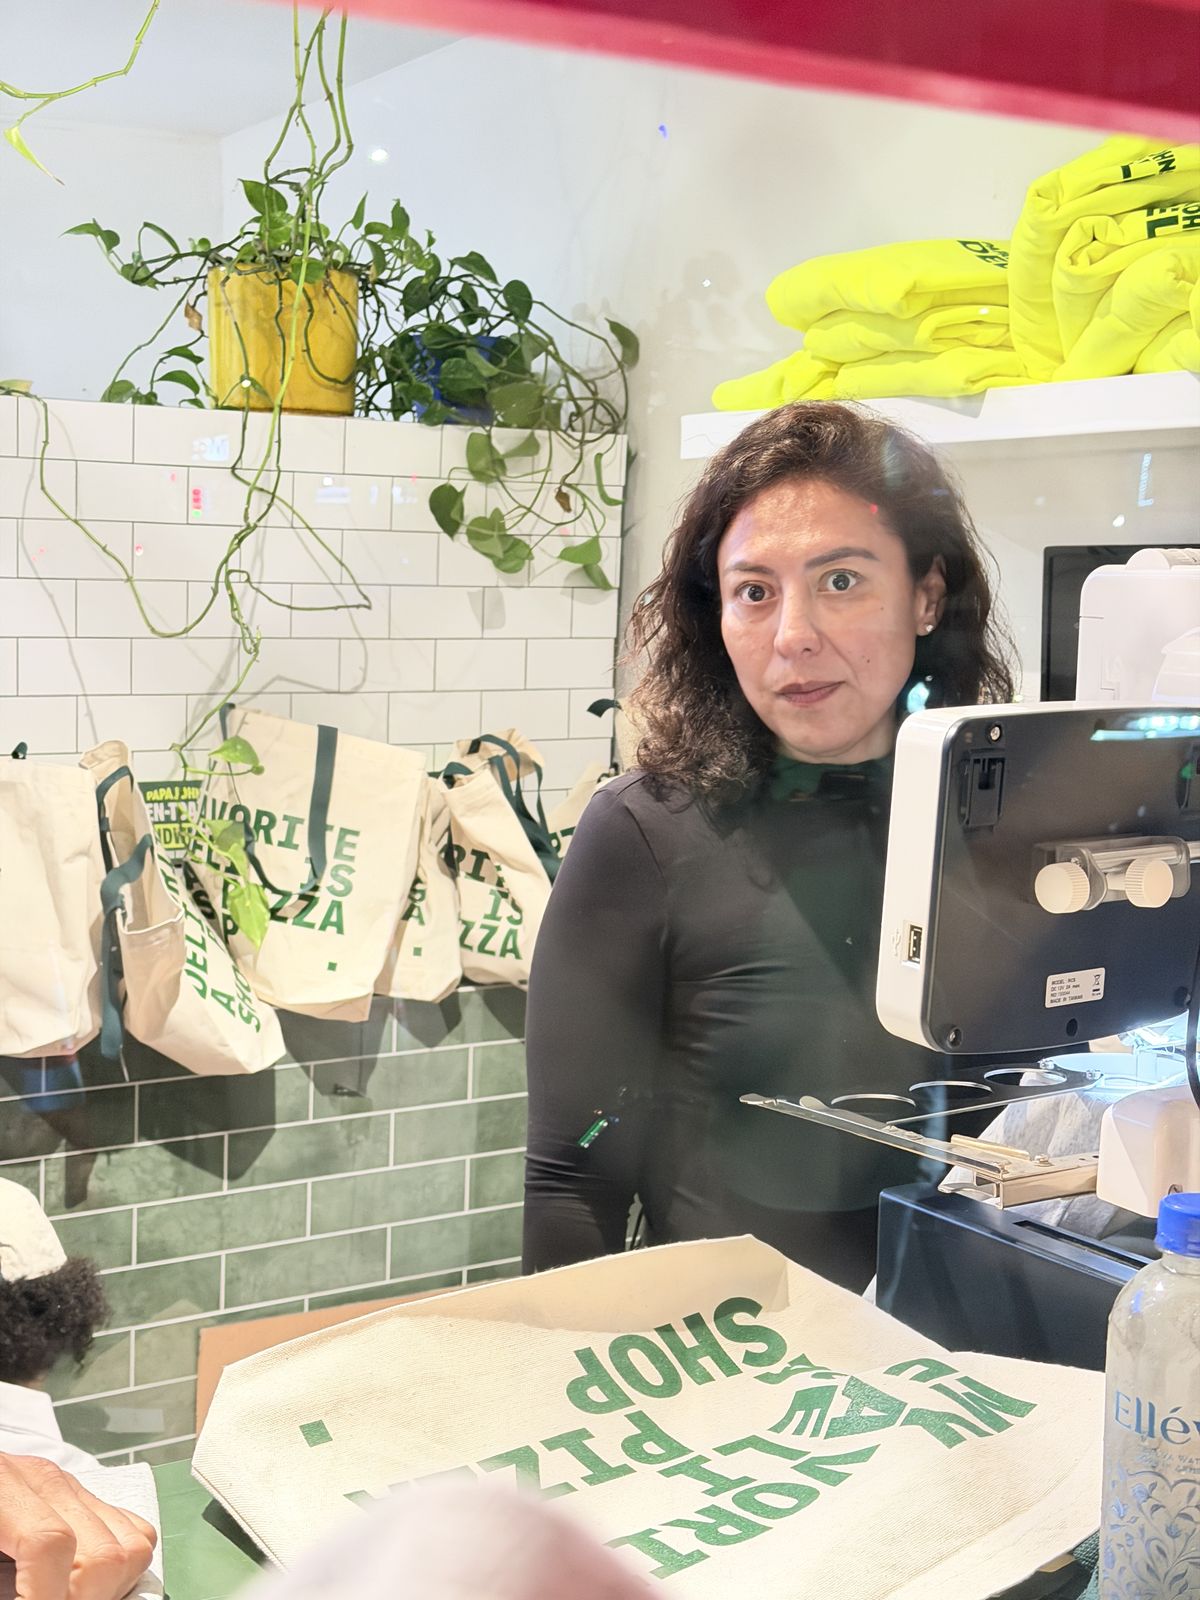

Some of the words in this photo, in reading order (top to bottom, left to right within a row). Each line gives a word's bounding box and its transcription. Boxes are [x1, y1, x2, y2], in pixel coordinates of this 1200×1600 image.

[197, 794, 361, 863] AVORIE
[222, 875, 345, 936] PZZA
[458, 916, 523, 960] ZZA
[232, 964, 261, 1033] SHO
[566, 1297, 788, 1415] SHOP
